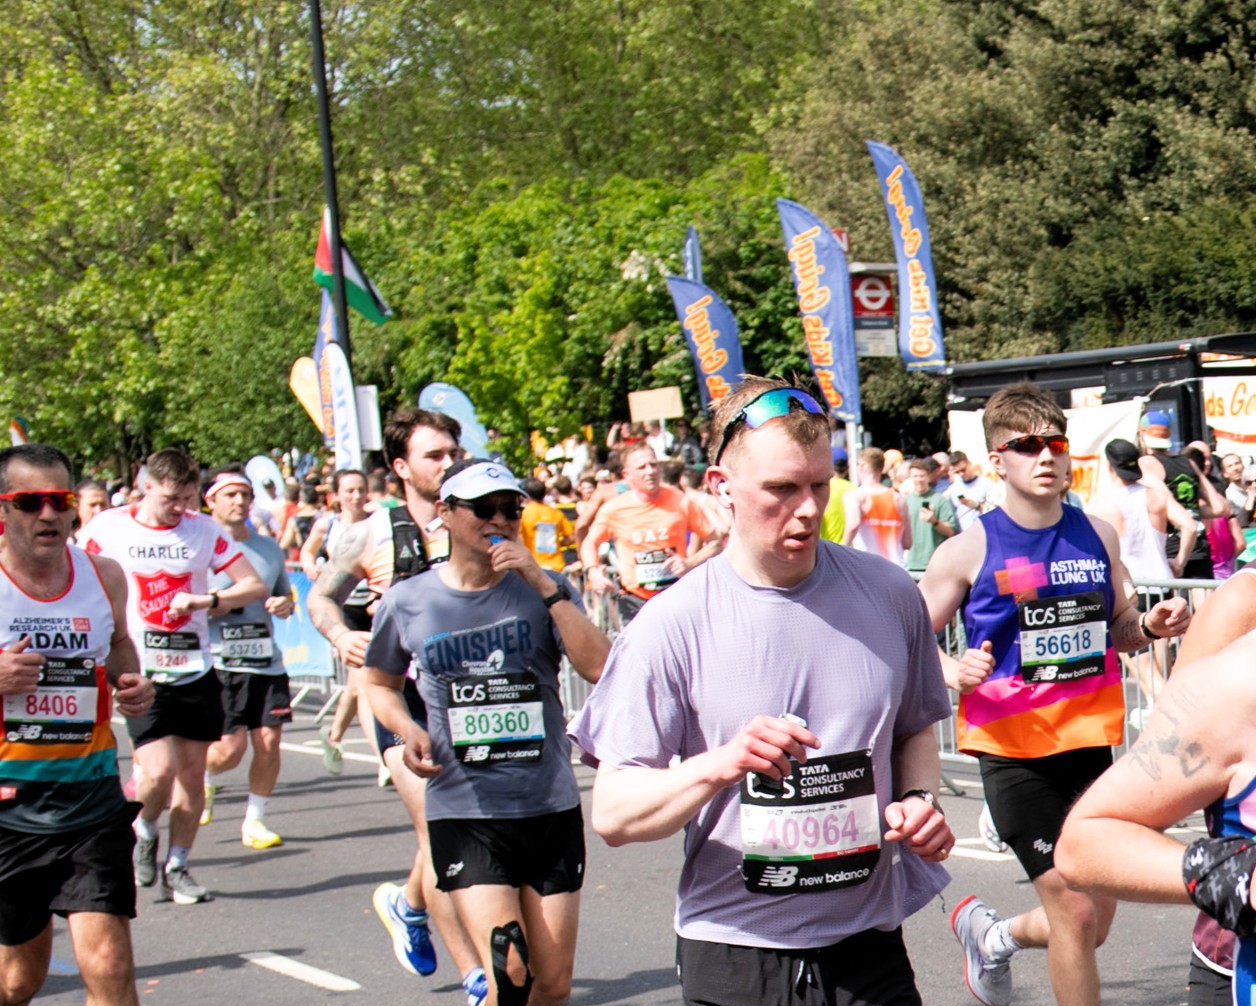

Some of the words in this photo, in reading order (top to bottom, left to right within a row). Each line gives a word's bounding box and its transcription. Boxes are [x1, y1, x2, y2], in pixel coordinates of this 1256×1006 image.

[1205, 391, 1225, 417] ds
[129, 545, 190, 560] CHARLIE
[146, 576, 169, 596] THE
[1051, 571, 1088, 585] LUNG
[1092, 570, 1106, 584] UK
[1024, 606, 1056, 626] tcs
[1057, 600, 1077, 608] TATA
[19, 632, 88, 649] ADAM
[424, 619, 533, 676] FINISHER
[1035, 629, 1092, 656] 56618
[1074, 666, 1098, 677] balance
[451, 682, 486, 703] tcs
[488, 678, 509, 686] TATA
[488, 683, 535, 693] CONSULTANCY
[488, 691, 520, 700] SERVICES
[25, 694, 78, 716] 8406
[464, 710, 530, 735] 80360
[490, 752, 505, 760] new
[507, 747, 540, 759] balance
[746, 771, 796, 799] ts
[799, 764, 830, 776] TATA
[800, 767, 865, 787] CONSULTANCY
[800, 783, 845, 798] SERVICES
[761, 810, 859, 850] 40964
[799, 874, 824, 886] new
[825, 868, 870, 883] balance
